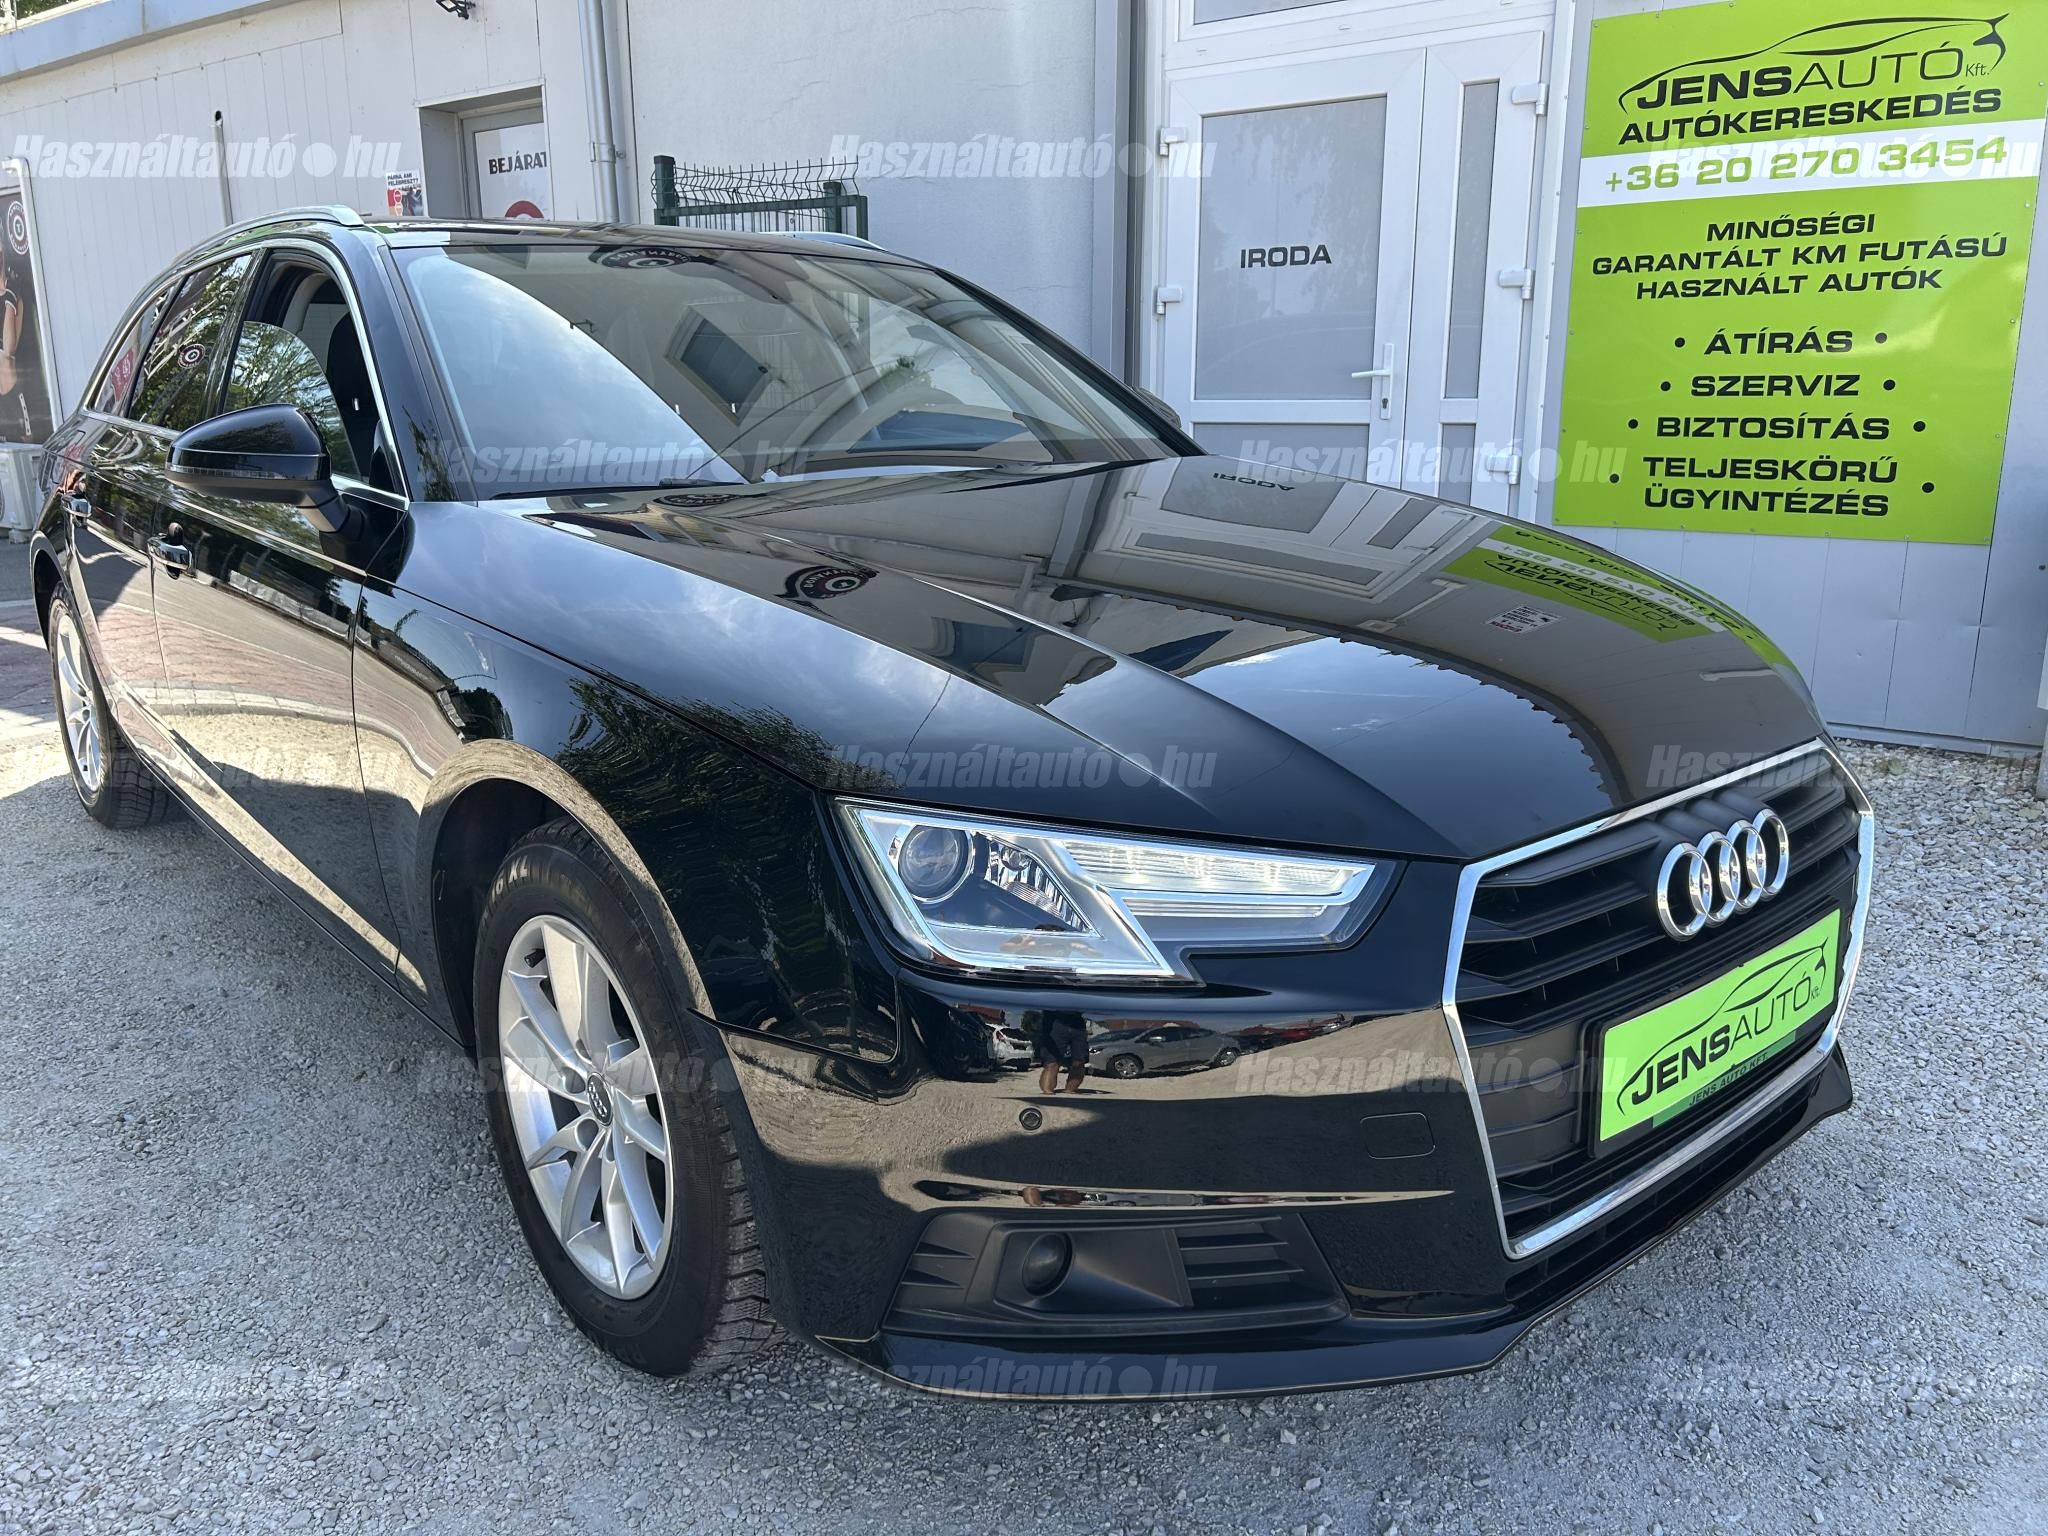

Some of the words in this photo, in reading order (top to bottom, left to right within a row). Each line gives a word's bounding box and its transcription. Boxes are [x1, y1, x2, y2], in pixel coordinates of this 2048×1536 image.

[1965, 62, 1990, 78] Kft.
[1617, 87, 2001, 145] AUTÓKERESKEDÉS
[1605, 163, 1680, 192] +36
[1697, 157, 1752, 185] 20
[1769, 148, 1859, 180] 270
[1879, 136, 2008, 172] 3454
[1706, 213, 1875, 242] MINŐSÉGI
[1239, 243, 1333, 269] IRODA
[1593, 246, 1775, 275] GARANTÁLT
[1792, 245, 1846, 265] KM
[1858, 232, 2008, 262] FUTÁSÚ
[1636, 272, 1808, 300] HASZNÁLT
[1818, 265, 1943, 295] AUTÓK
[1704, 326, 1853, 355] ÁTÍRÁS
[1690, 374, 1861, 397] SZERVIZ
[1656, 412, 1890, 440] BIZTOSÍTÁS
[1642, 455, 1899, 484] TELJESKÖRŰ
[1643, 484, 1889, 517] ÜGYINTÉZÉS
[1689, 1083, 1717, 1106] JENS
